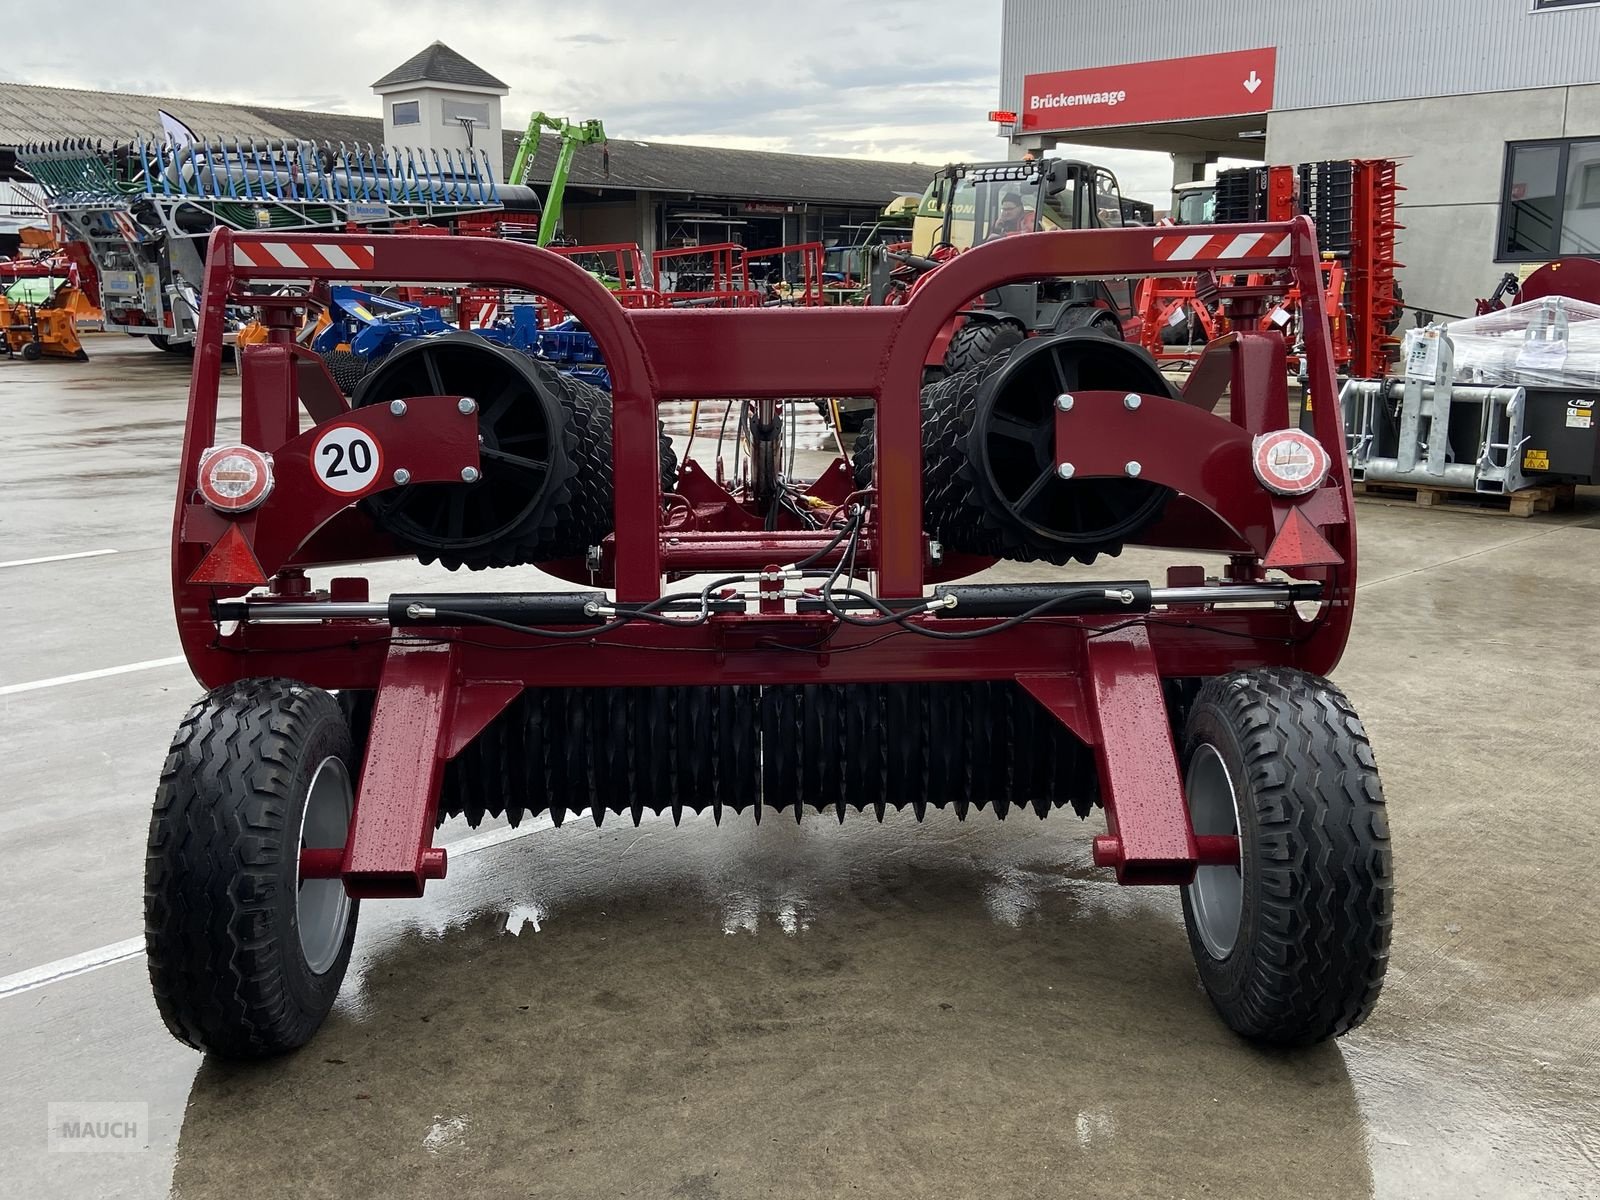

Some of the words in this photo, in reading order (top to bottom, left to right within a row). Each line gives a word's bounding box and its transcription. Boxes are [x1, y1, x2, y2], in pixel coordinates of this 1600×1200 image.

[1030, 90, 1126, 109] Brückenwaage
[520, 153, 535, 185] ERLO
[322, 439, 372, 478] 20
